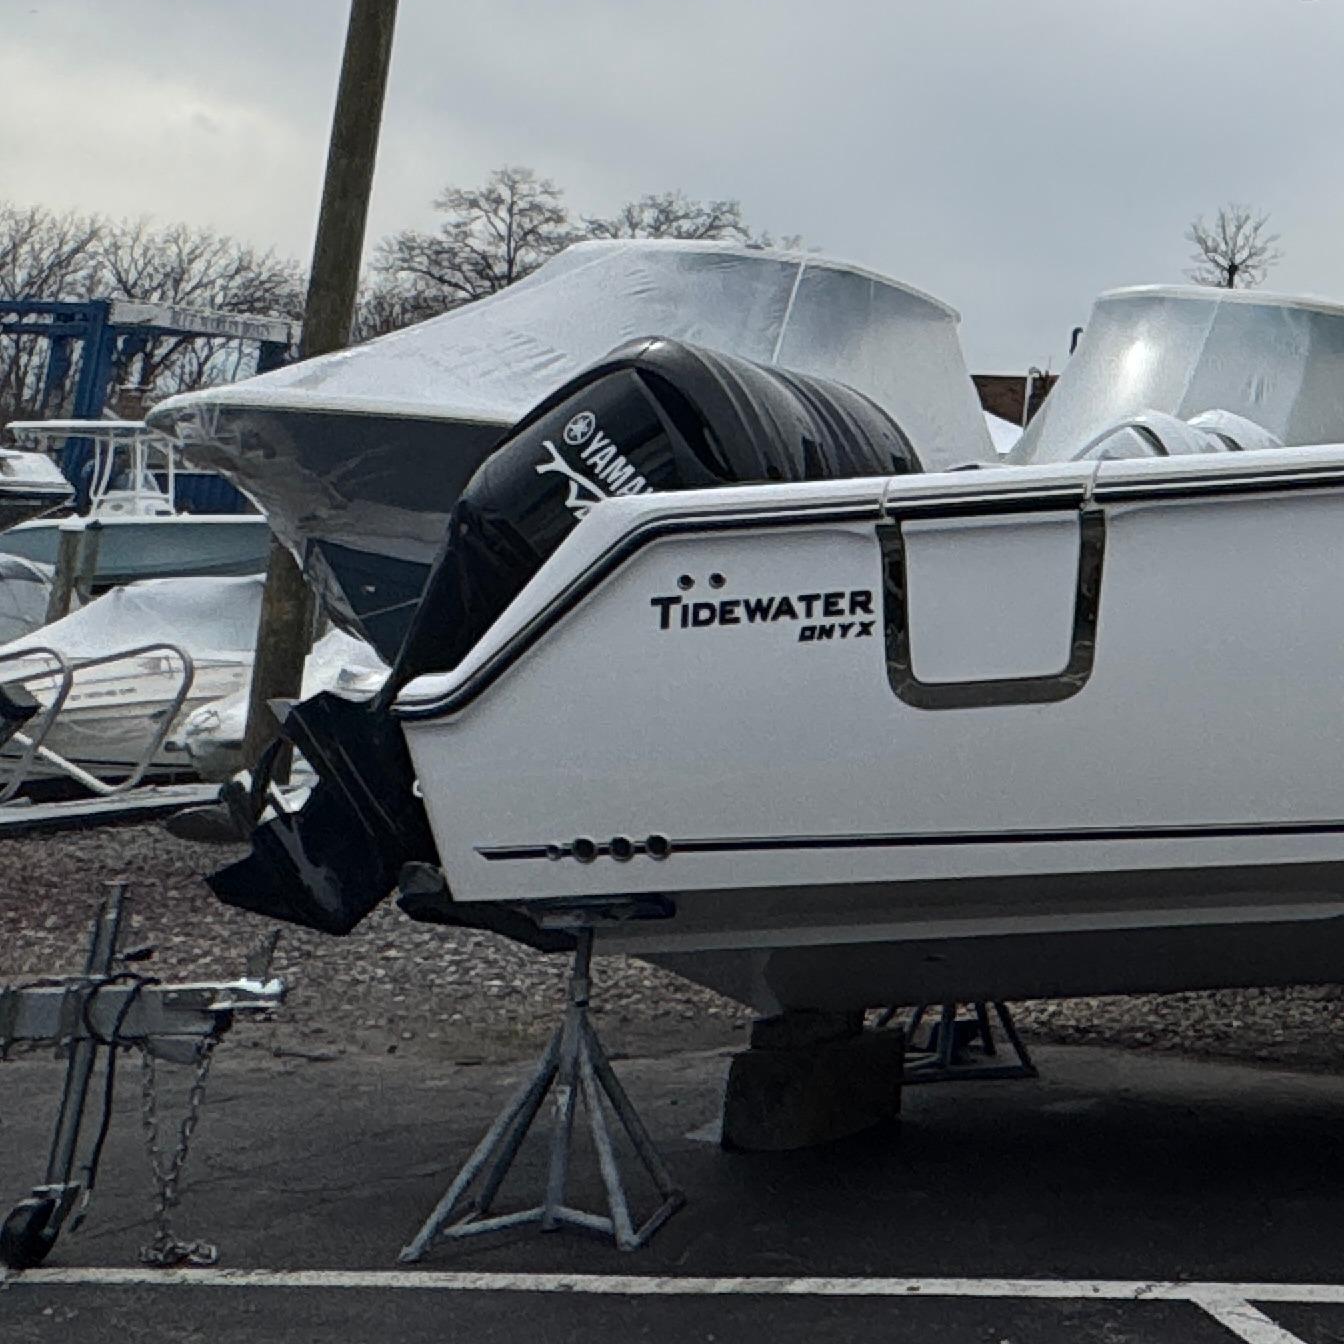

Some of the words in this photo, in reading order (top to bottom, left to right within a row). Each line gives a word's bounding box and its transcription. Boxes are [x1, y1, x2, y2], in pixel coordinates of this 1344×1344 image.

[580, 430, 655, 496] YAMA
[650, 590, 874, 630] TIDEWATER
[798, 620, 876, 643] ONYX
